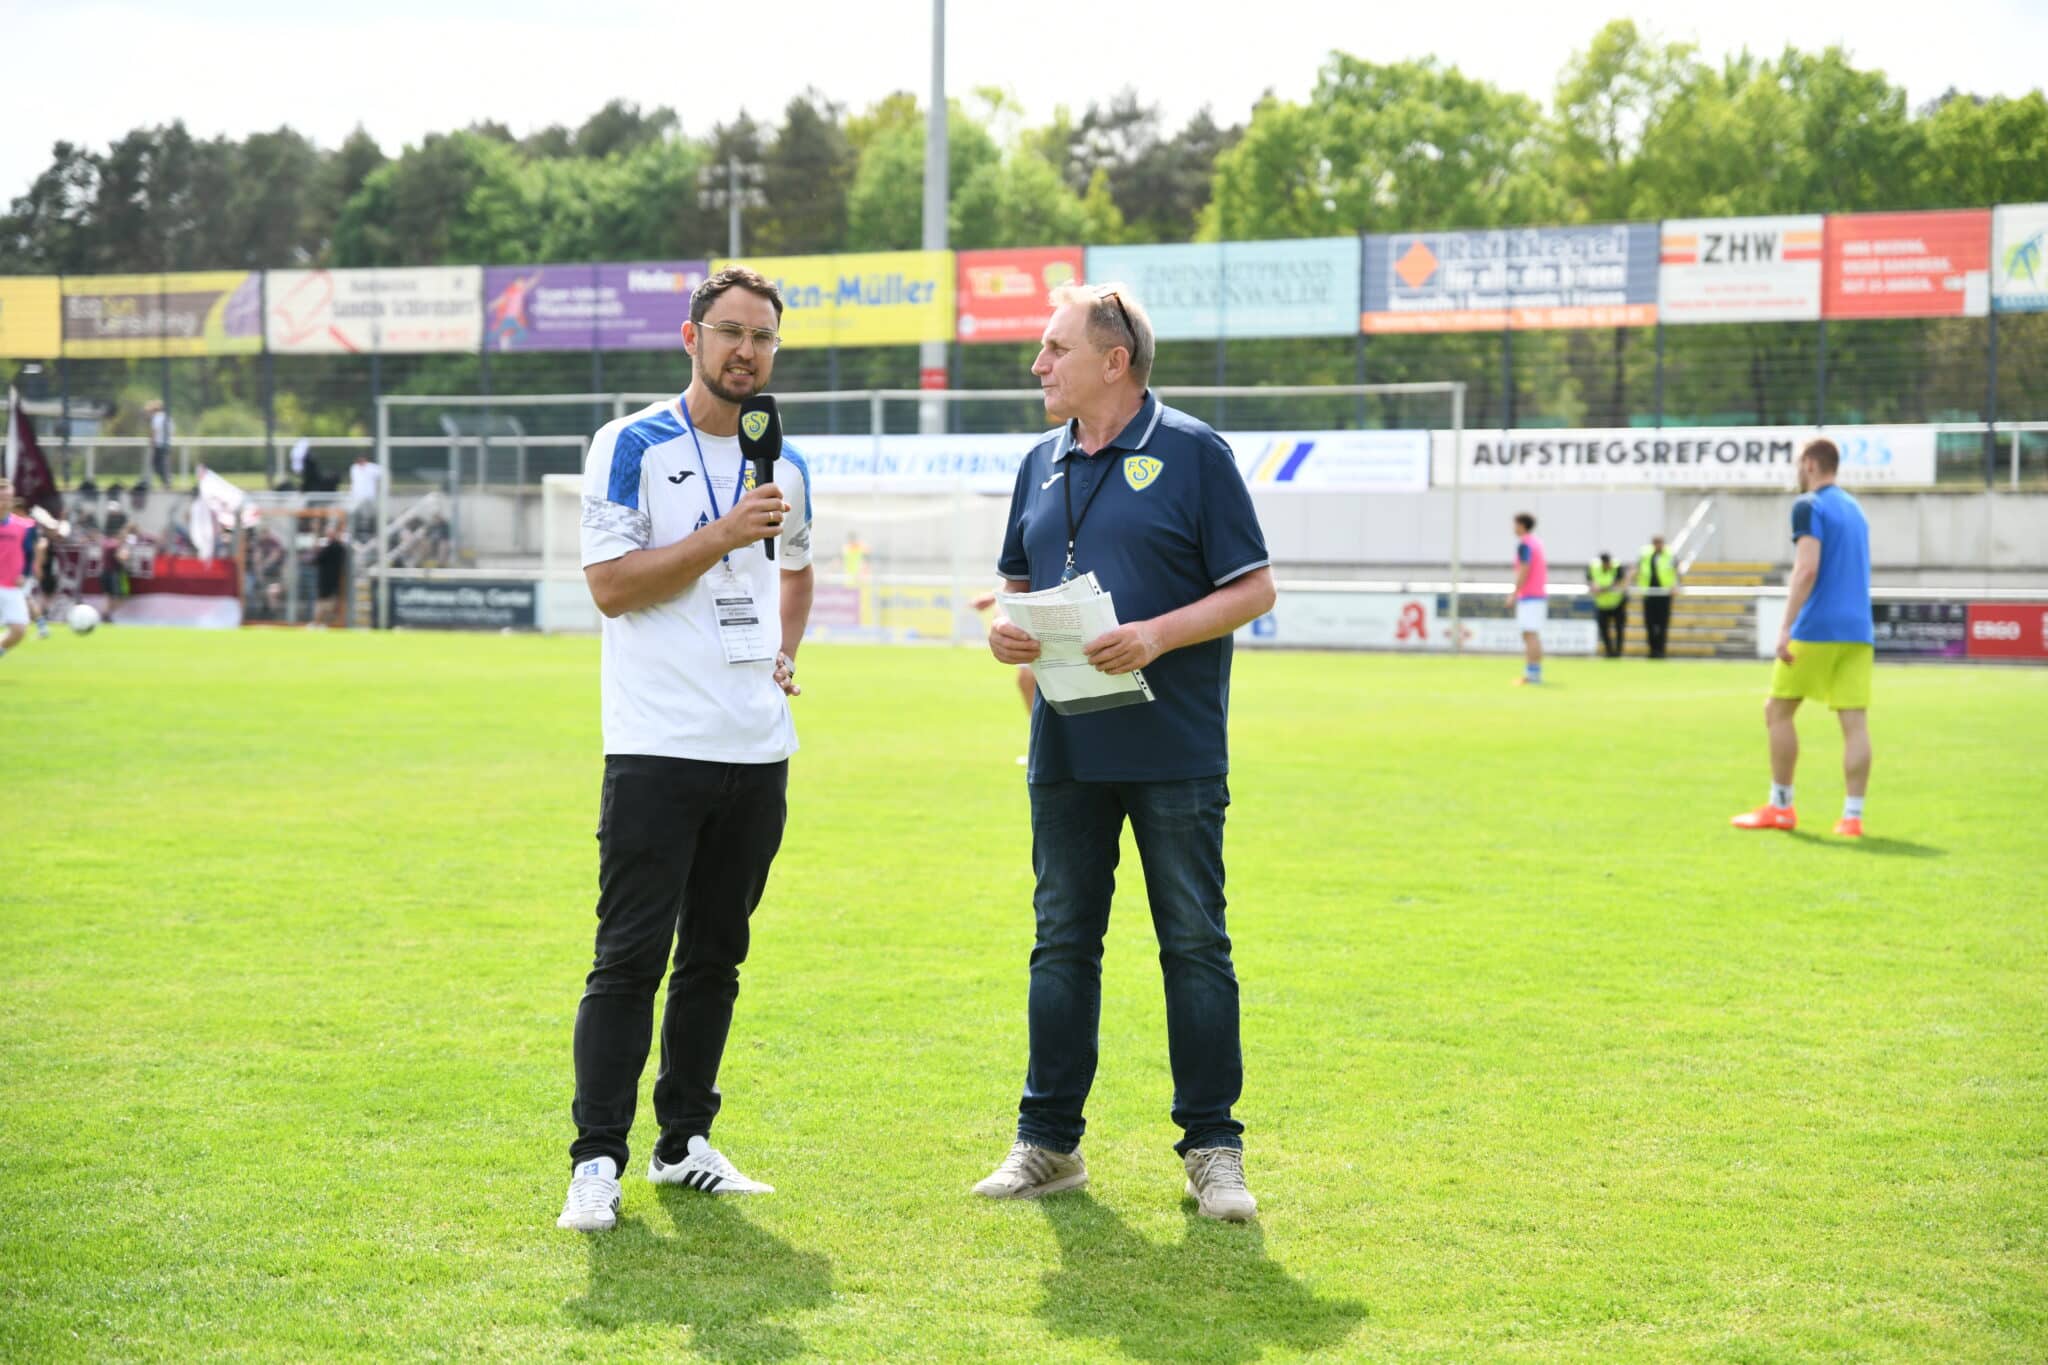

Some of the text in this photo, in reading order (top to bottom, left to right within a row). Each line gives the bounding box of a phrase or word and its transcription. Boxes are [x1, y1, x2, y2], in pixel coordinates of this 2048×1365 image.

[1704, 231, 1777, 263] ZHW
[1473, 440, 1794, 466] AUFSTIEGSREFORM
[1972, 620, 2022, 641] ERGO
